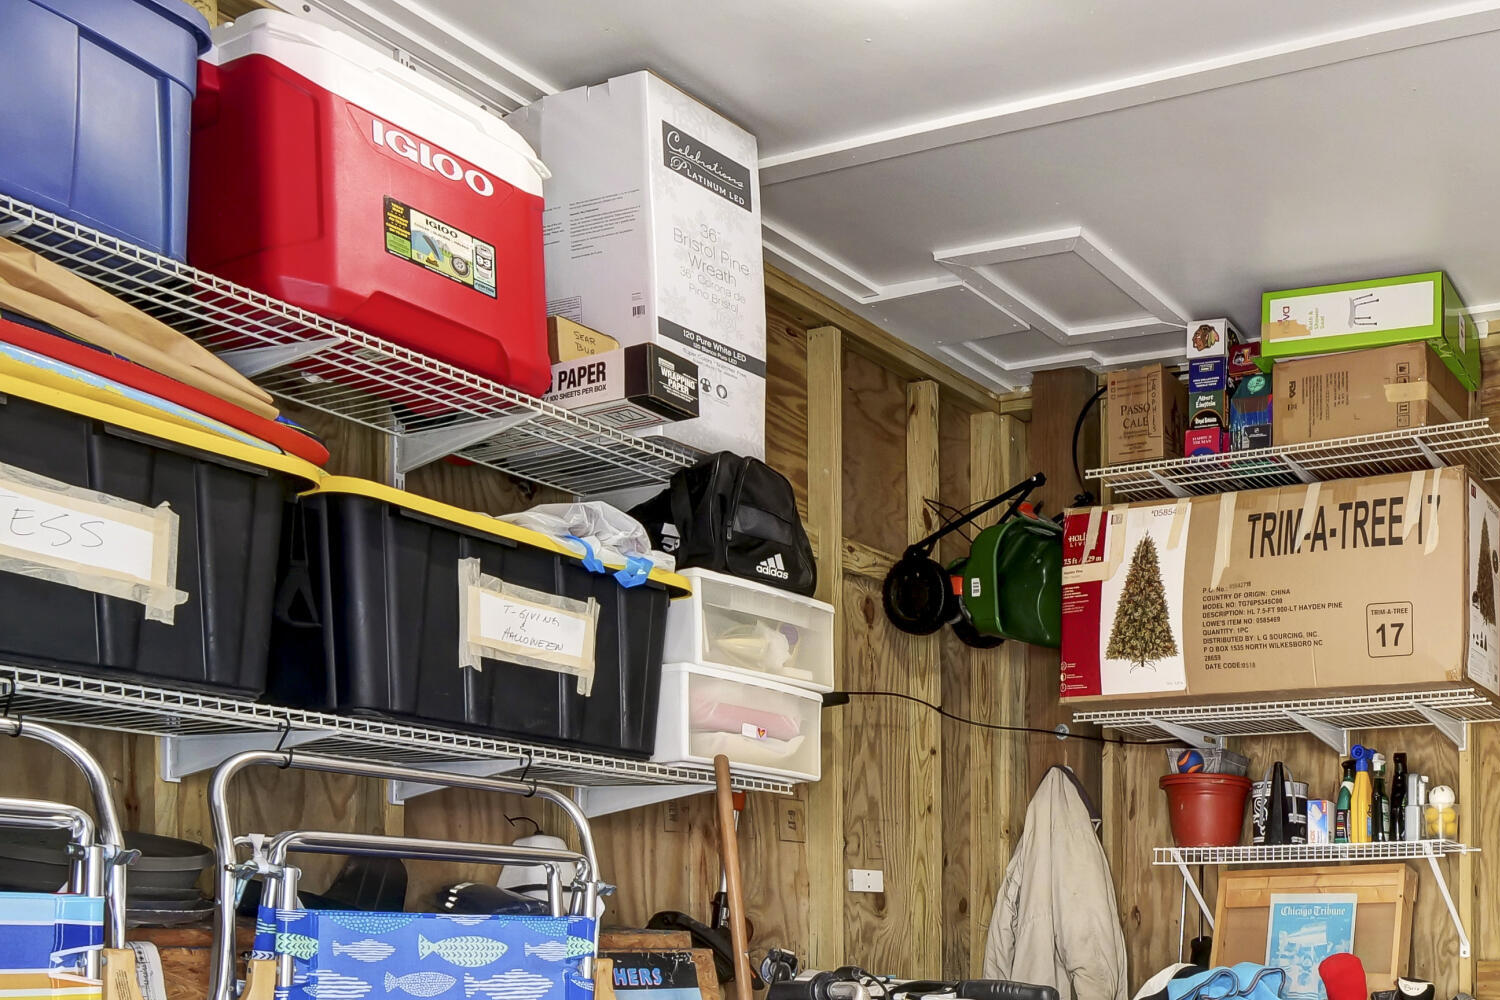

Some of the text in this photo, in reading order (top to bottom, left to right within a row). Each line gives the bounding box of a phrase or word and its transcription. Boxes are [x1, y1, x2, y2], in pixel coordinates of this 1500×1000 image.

[372, 120, 494, 197] IGLOO
[667, 130, 744, 188] Celebrations
[670, 156, 745, 206] PLATINUM LED
[425, 218, 458, 239] IGLOO
[673, 227, 750, 277] Bristol Pine
[688, 252, 737, 288] Wreath
[683, 329, 695, 340] 120
[696, 334, 712, 348] Pure
[713, 341, 732, 357] White
[733, 351, 747, 363] LED
[558, 362, 607, 391] PAPER
[660, 367, 696, 391] WRAPPING
[559, 388, 581, 401] SHEETS
[582, 387, 594, 396] PER
[594, 384, 607, 393] BOX
[668, 377, 689, 396] PAPER
[1197, 394, 1215, 403] Albert
[1248, 496, 1403, 559] TRIM-A-TREE
[755, 565, 789, 580] adidas
[1203, 593, 1232, 602] COUNTRY
[1203, 602, 1225, 610] MODEL
[1203, 609, 1245, 618] DESCRIPTION:
[1299, 602, 1326, 611] HAYDEN
[1371, 607, 1408, 616] TRIM-A-TREE
[1237, 626, 1249, 634] 1PC
[1376, 623, 1405, 648] 17
[1203, 636, 1244, 644] DISTRIBUTED
[1245, 643, 1268, 651] NORTH
[1269, 640, 1312, 649] WILKESBORO
[1313, 639, 1323, 647] NC
[1281, 905, 1345, 917] Chicago Tribune
[613, 968, 663, 986] HERS
